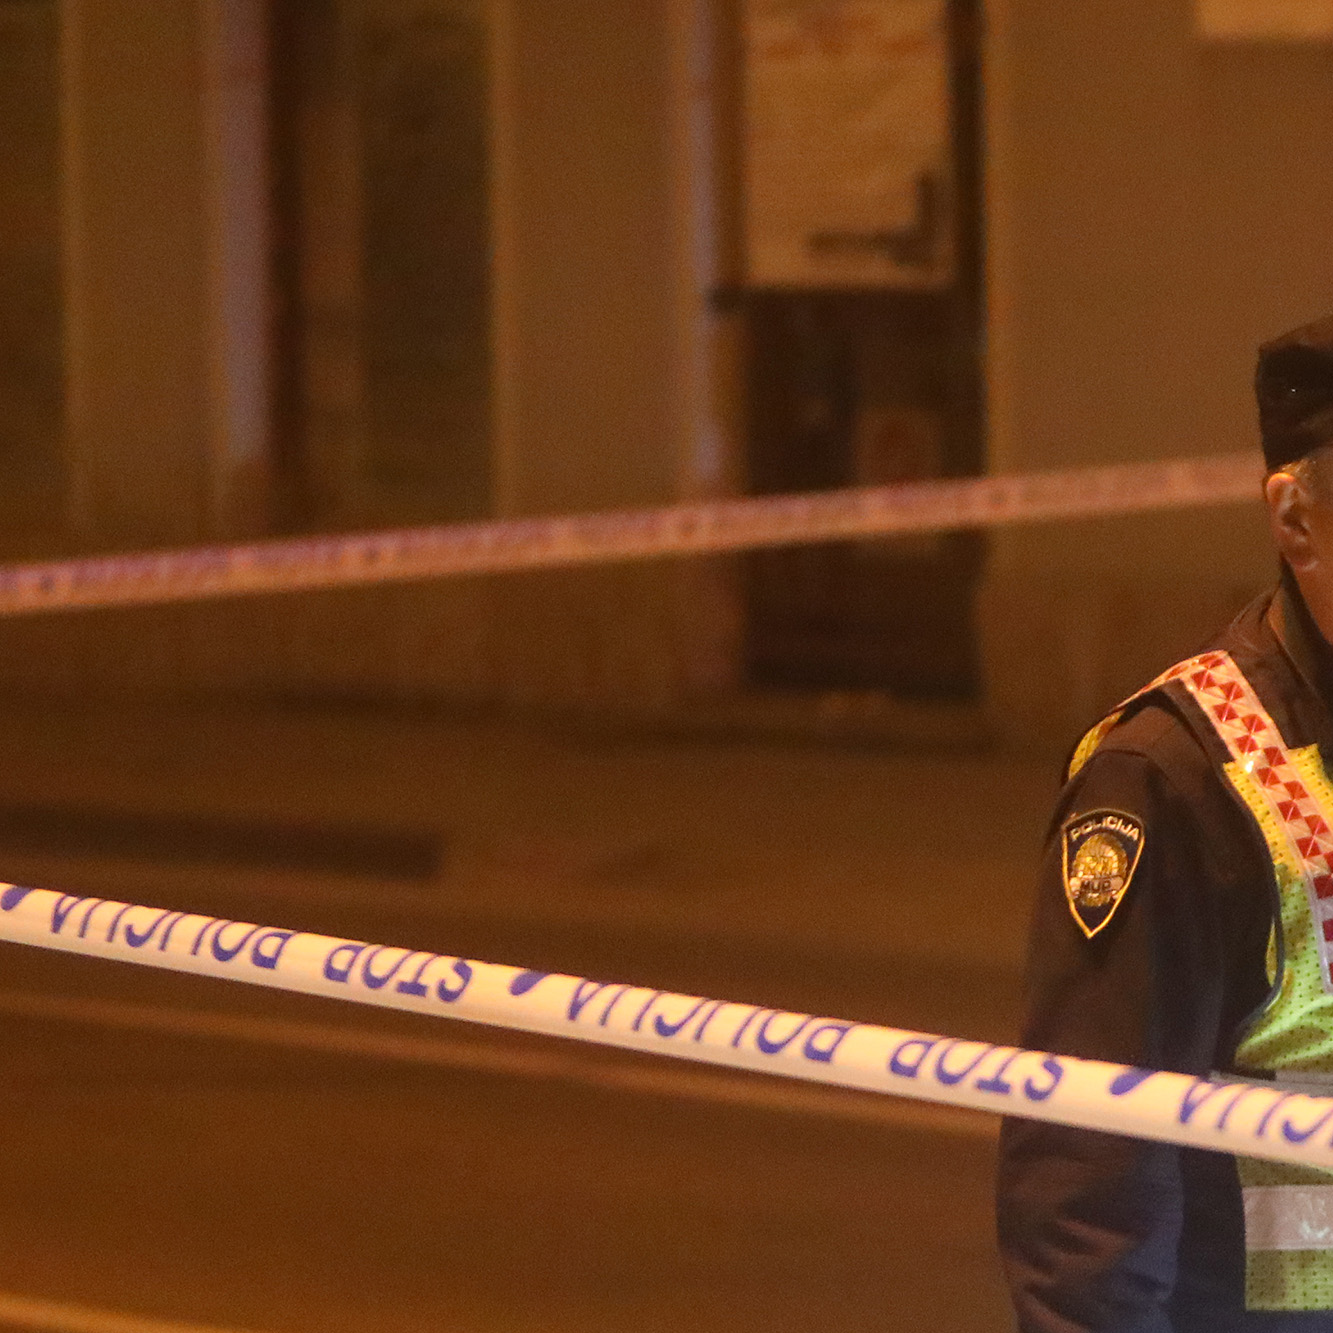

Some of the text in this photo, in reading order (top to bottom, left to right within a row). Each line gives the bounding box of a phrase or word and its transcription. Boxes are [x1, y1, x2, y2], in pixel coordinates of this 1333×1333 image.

[1070, 815, 1140, 842] POLICIJA
[322, 941, 473, 1002] STOP
[889, 1038, 1064, 1101] STOP
